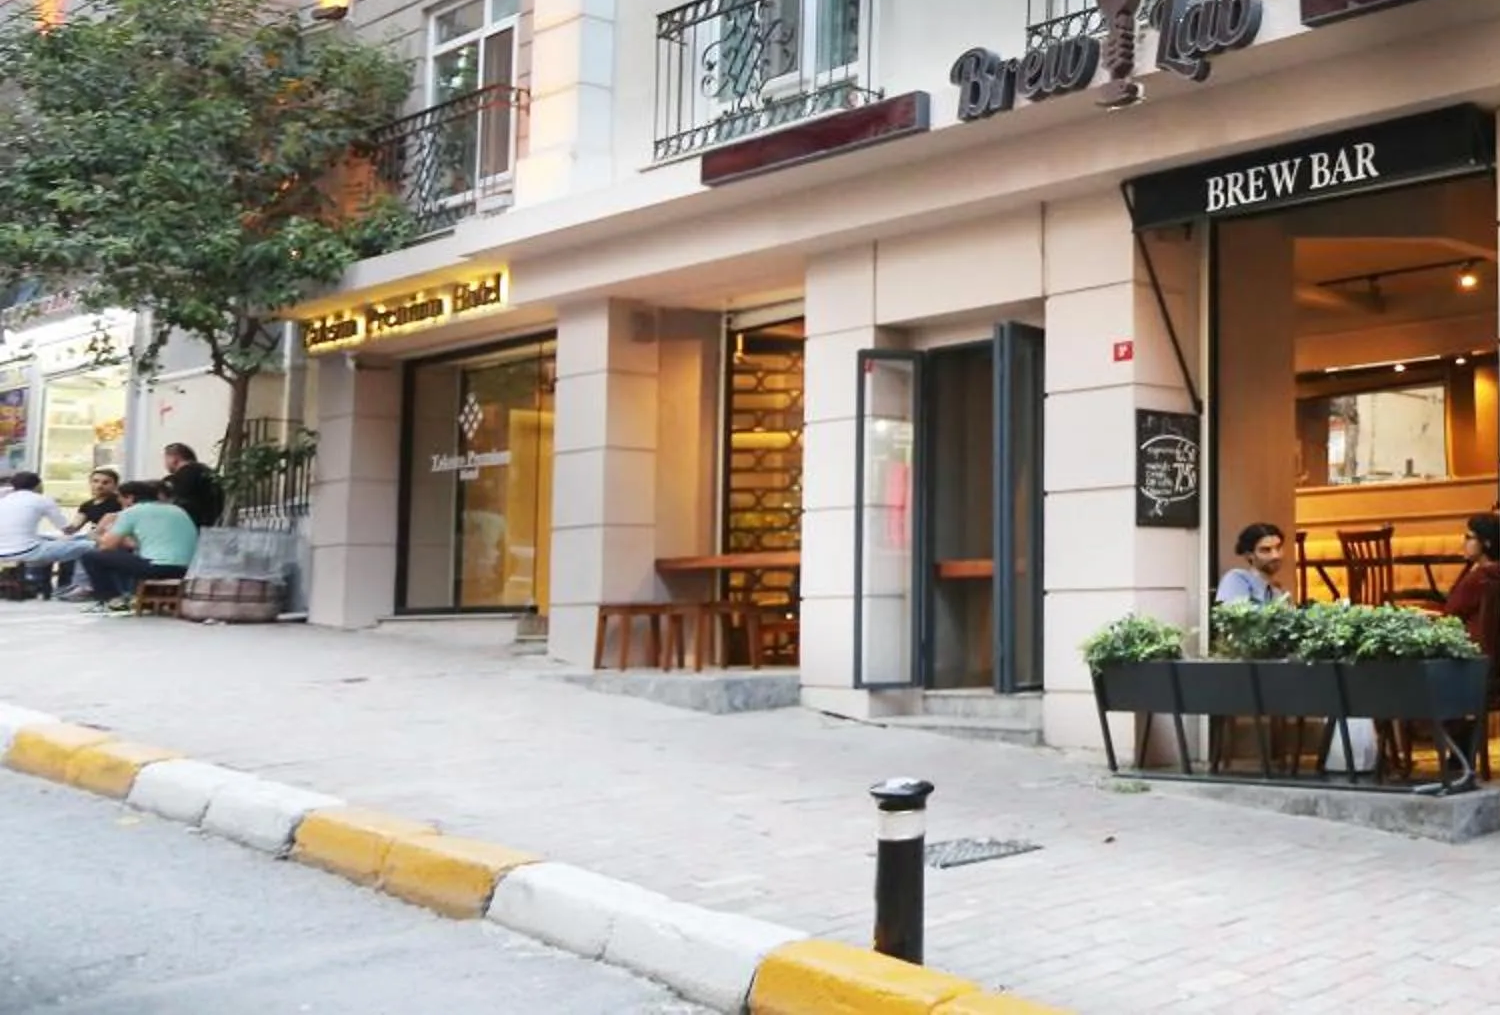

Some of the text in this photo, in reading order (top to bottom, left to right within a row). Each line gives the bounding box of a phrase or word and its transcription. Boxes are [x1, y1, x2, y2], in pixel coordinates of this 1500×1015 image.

[950, 35, 1099, 121] Brew
[1205, 142, 1379, 212] BREW BAR
